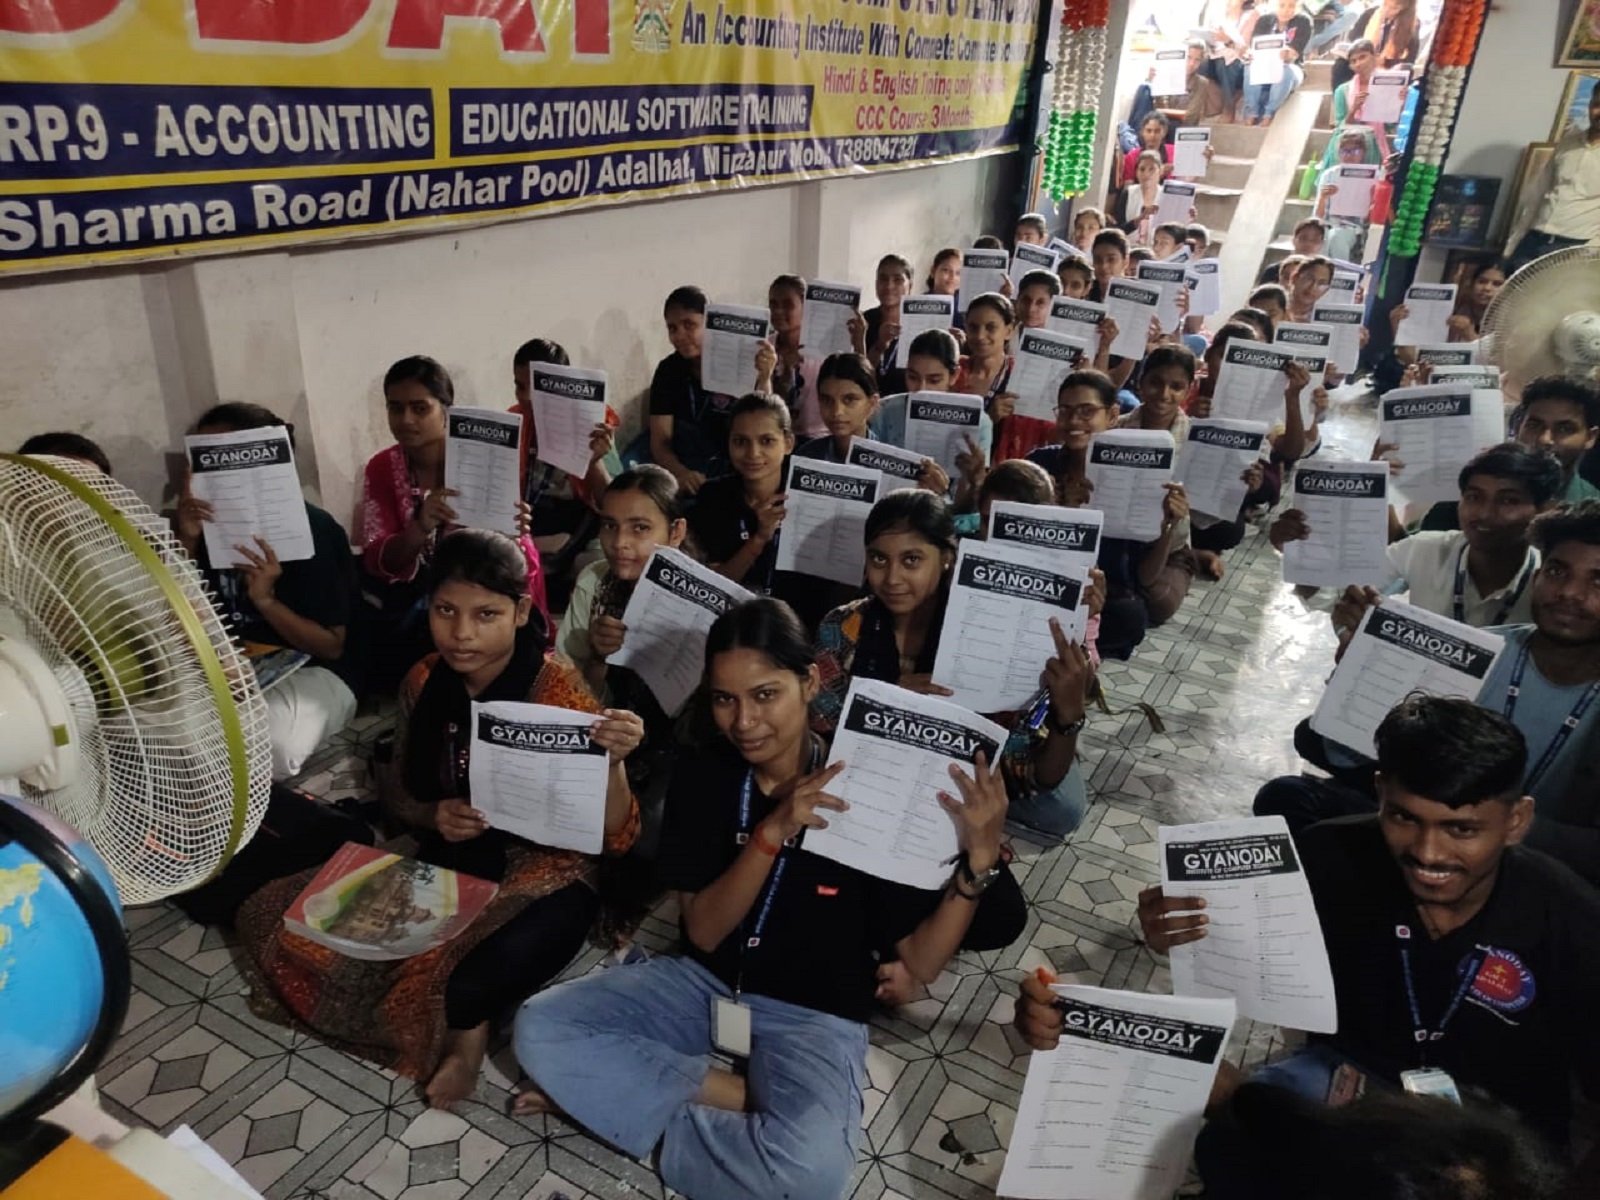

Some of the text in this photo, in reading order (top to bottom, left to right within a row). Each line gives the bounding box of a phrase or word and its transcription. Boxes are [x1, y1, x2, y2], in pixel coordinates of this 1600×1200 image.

[681, 0, 706, 44] An
[713, 3, 801, 60] Accounting
[805, 14, 864, 55] Institute
[869, 22, 900, 58] With
[823, 65, 856, 94] Hindi
[859, 68, 868, 94] &
[873, 69, 919, 100] English
[462, 93, 808, 146] EDUCATIONAL SOFTWARE TRAINING
[856, 105, 886, 130] CCC
[0, 104, 109, 162] RP.9
[155, 104, 431, 157] ACCOUNTING
[0, 197, 237, 252] Sharma
[252, 180, 371, 230] Road
[385, 172, 513, 222] (Nahar
[521, 157, 591, 200] Pool)
[597, 146, 696, 190] Adalhat,
[703, 142, 787, 176] Mirzapur
[811, 288, 855, 303] GYANODAY
[908, 303, 947, 313] GYANODAY
[713, 317, 761, 333] GYANODAY
[1028, 340, 1076, 358] GYANODAY
[1233, 350, 1285, 367] GYANODAY
[540, 378, 597, 396] GYANODAY
[918, 405, 973, 422] GYANODAY
[1393, 401, 1461, 417] GYANODAY
[458, 422, 511, 440] GYANODAY
[1197, 430, 1255, 447] GYANODAY
[200, 446, 279, 465] GYANODAY
[858, 452, 920, 476] GYANODAY
[1100, 449, 1165, 464] GYANODAY
[800, 474, 867, 496] GYANODAY
[1302, 476, 1374, 492] GYANODAY
[1004, 522, 1086, 543] GYANODAY
[660, 568, 731, 610] GYANODA
[973, 566, 1067, 597] GYANODAY
[1382, 620, 1477, 664] GYANODAY
[491, 725, 591, 746] GYANODAY
[864, 712, 981, 752] GYANODAY
[1184, 845, 1283, 870] GYANODAY
[1065, 1011, 1203, 1049] GYANODAY
